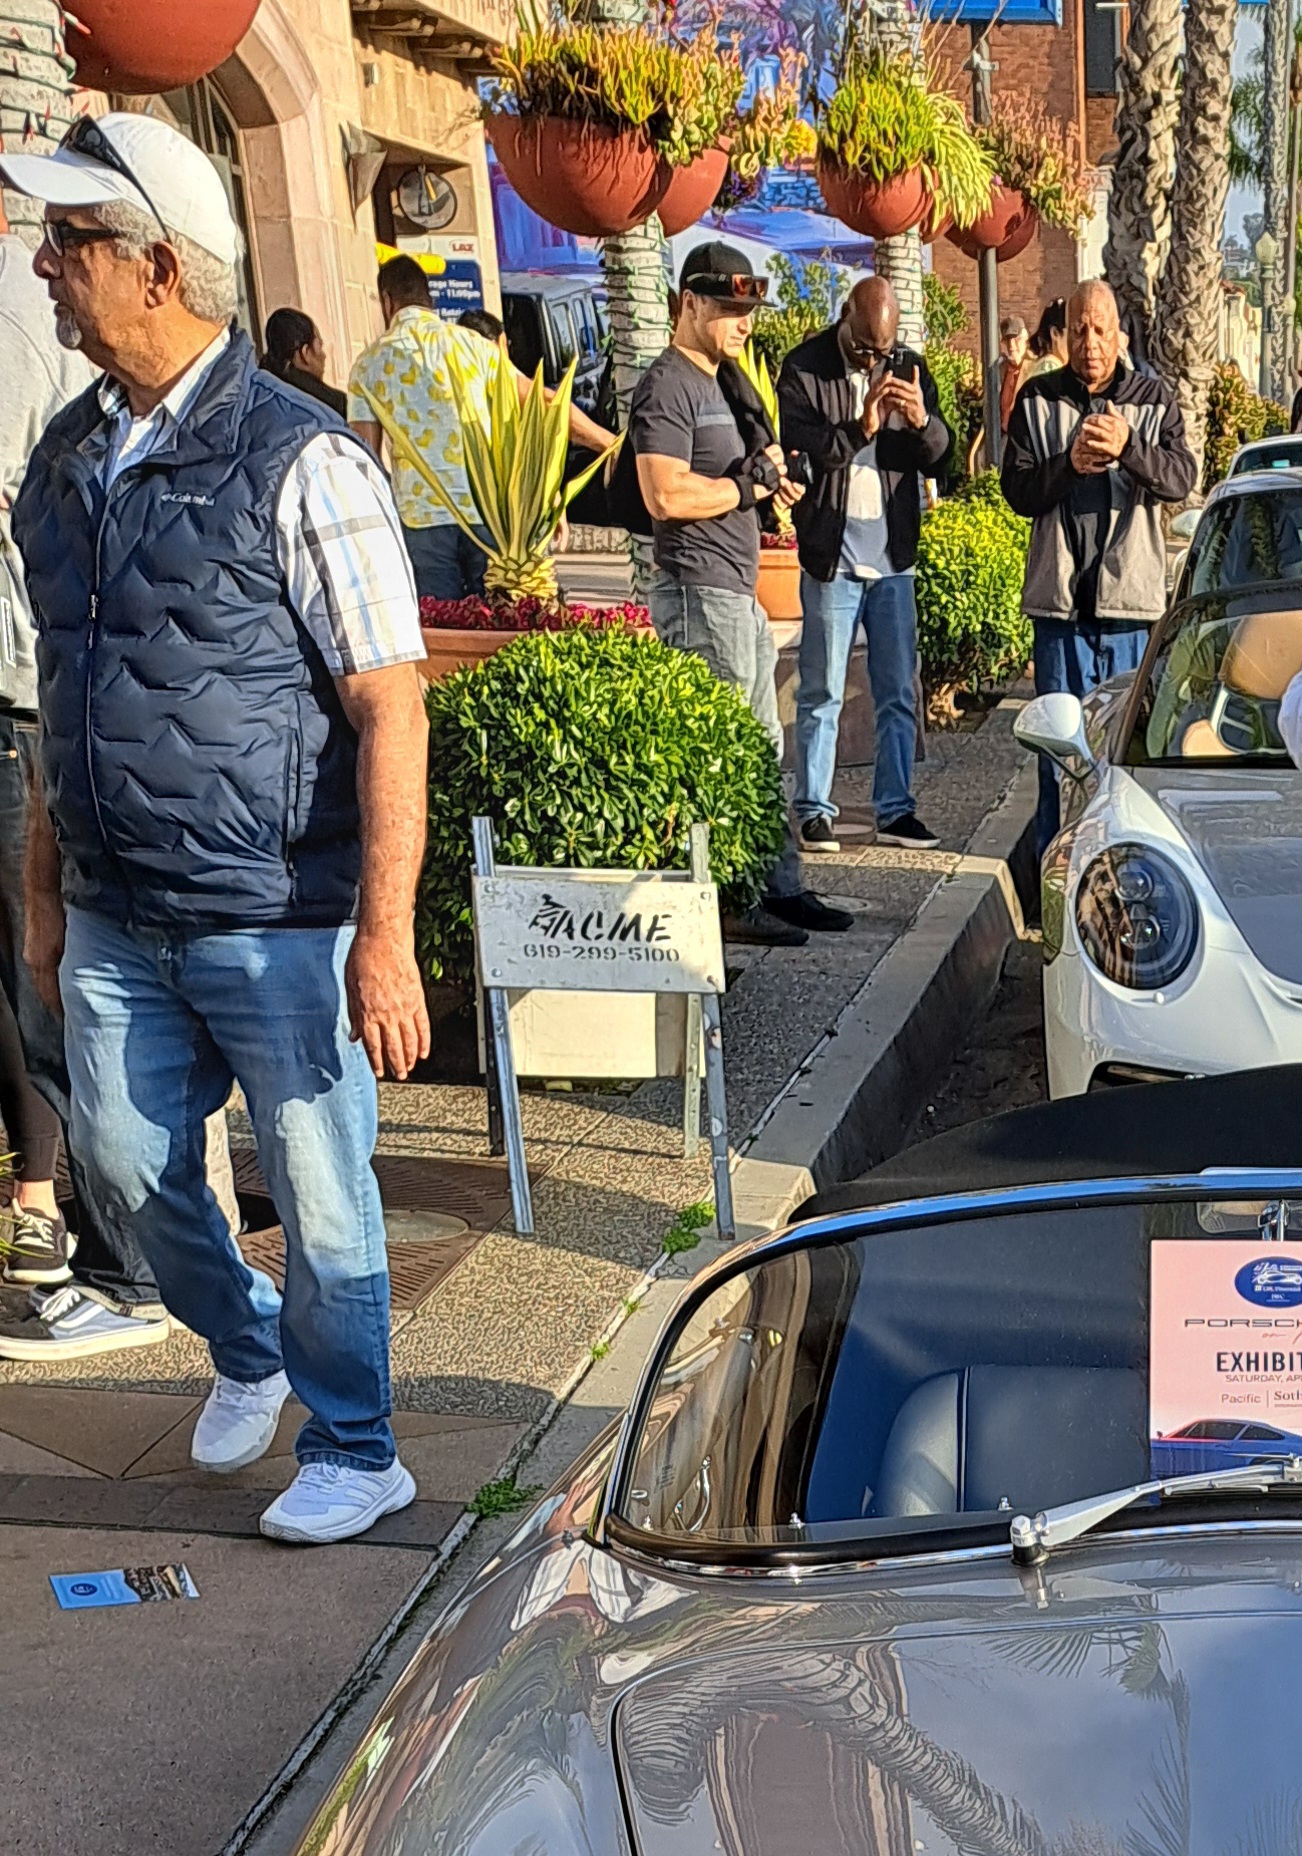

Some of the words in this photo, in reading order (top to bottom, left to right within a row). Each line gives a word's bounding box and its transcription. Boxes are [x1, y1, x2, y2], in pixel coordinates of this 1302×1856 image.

[549, 909, 673, 943] ACME
[523, 943, 680, 962] 619-299-5100
[1225, 1374, 1284, 1384] SATURDAY,
[1221, 1393, 1262, 1404] Pacific
